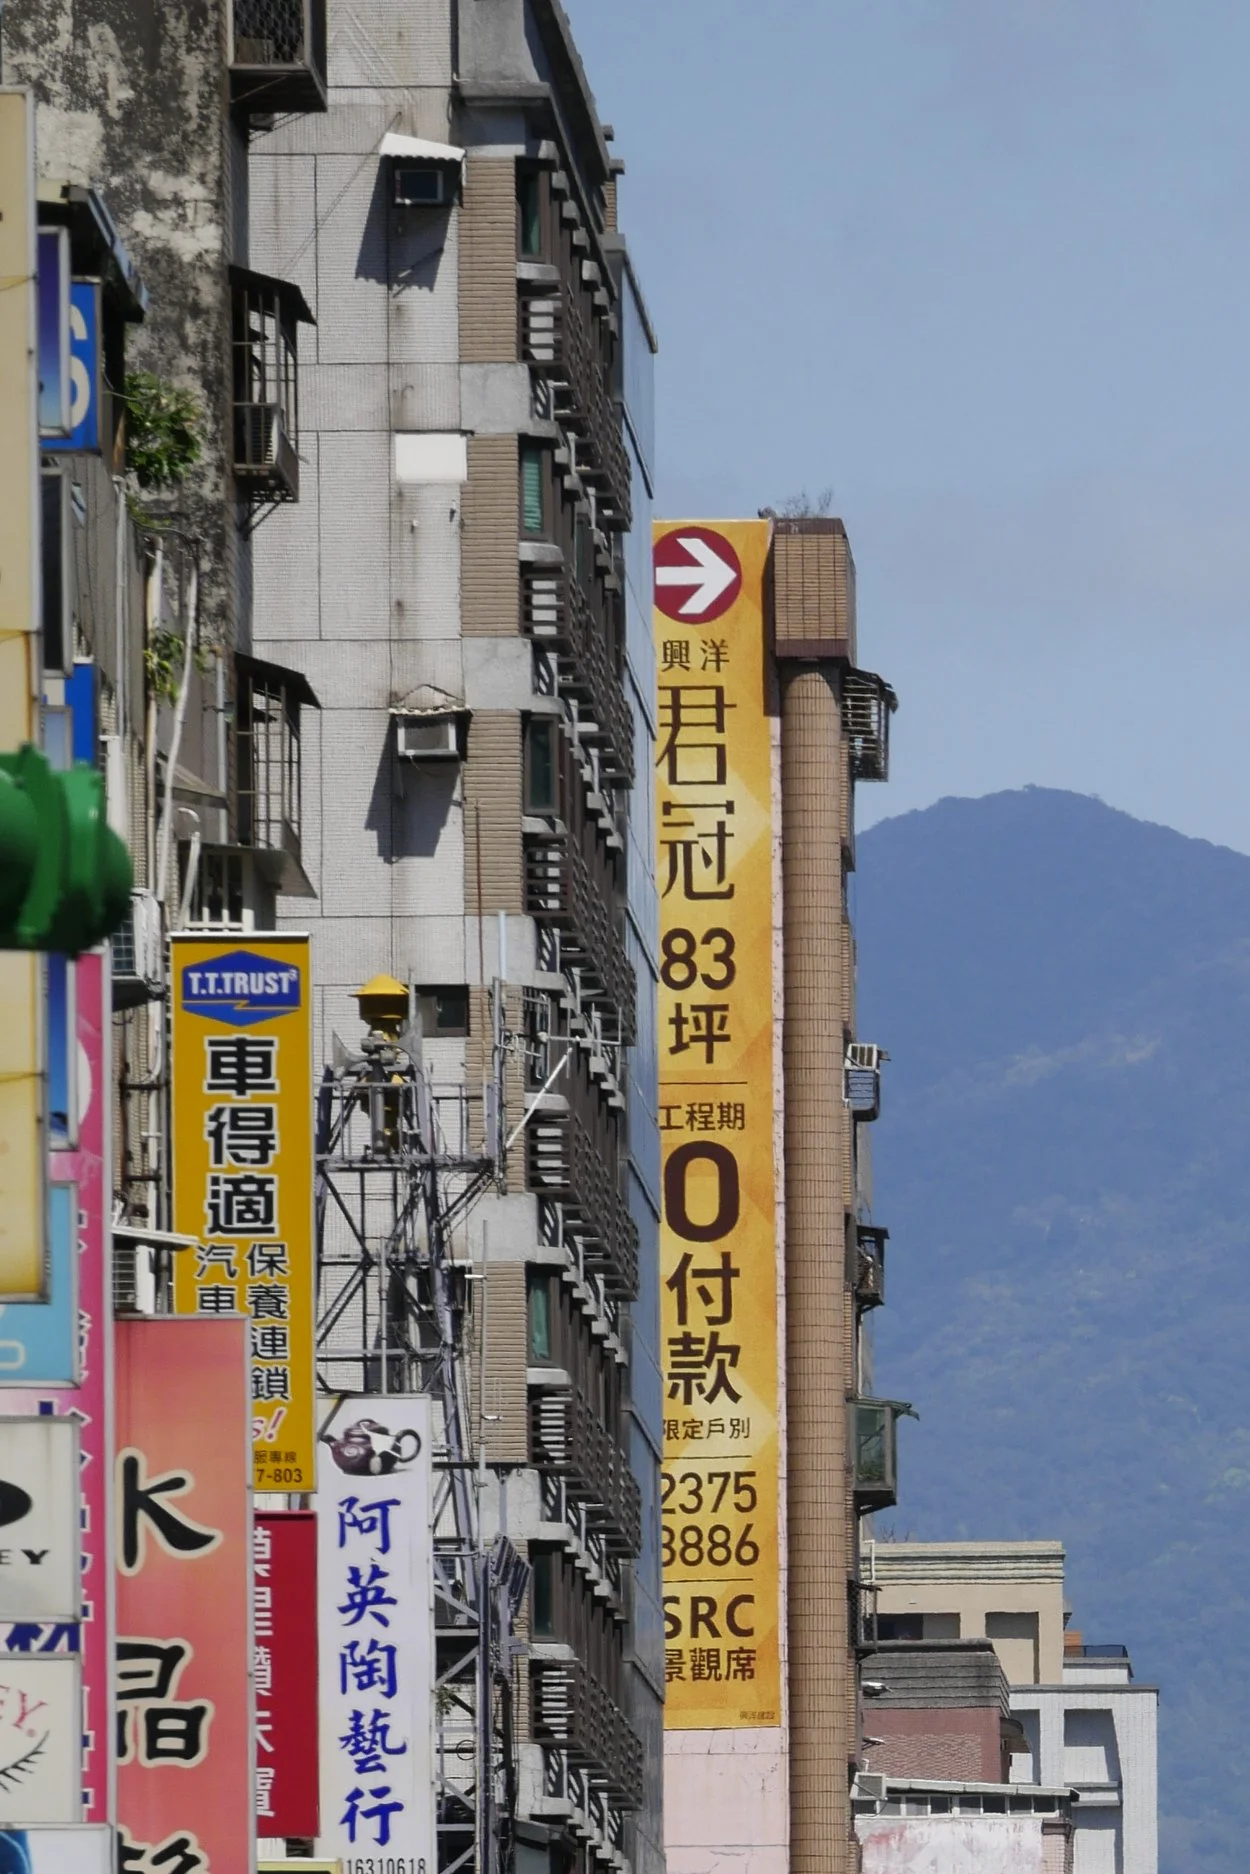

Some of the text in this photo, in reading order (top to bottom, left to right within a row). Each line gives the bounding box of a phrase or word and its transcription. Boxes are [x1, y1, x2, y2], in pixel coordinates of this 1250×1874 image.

[661, 639, 730, 672] 興洋
[657, 684, 737, 901] 君冠
[660, 928, 735, 990] 83
[669, 1003, 730, 1064] 坪
[205, 1036, 278, 1237] 車得適
[659, 1102, 746, 1132] 工程期
[247, 1242, 290, 1402] 保養連鎖
[662, 1417, 751, 1442] 限定戶別
[338, 1495, 408, 1847] 阿英陶藝行
